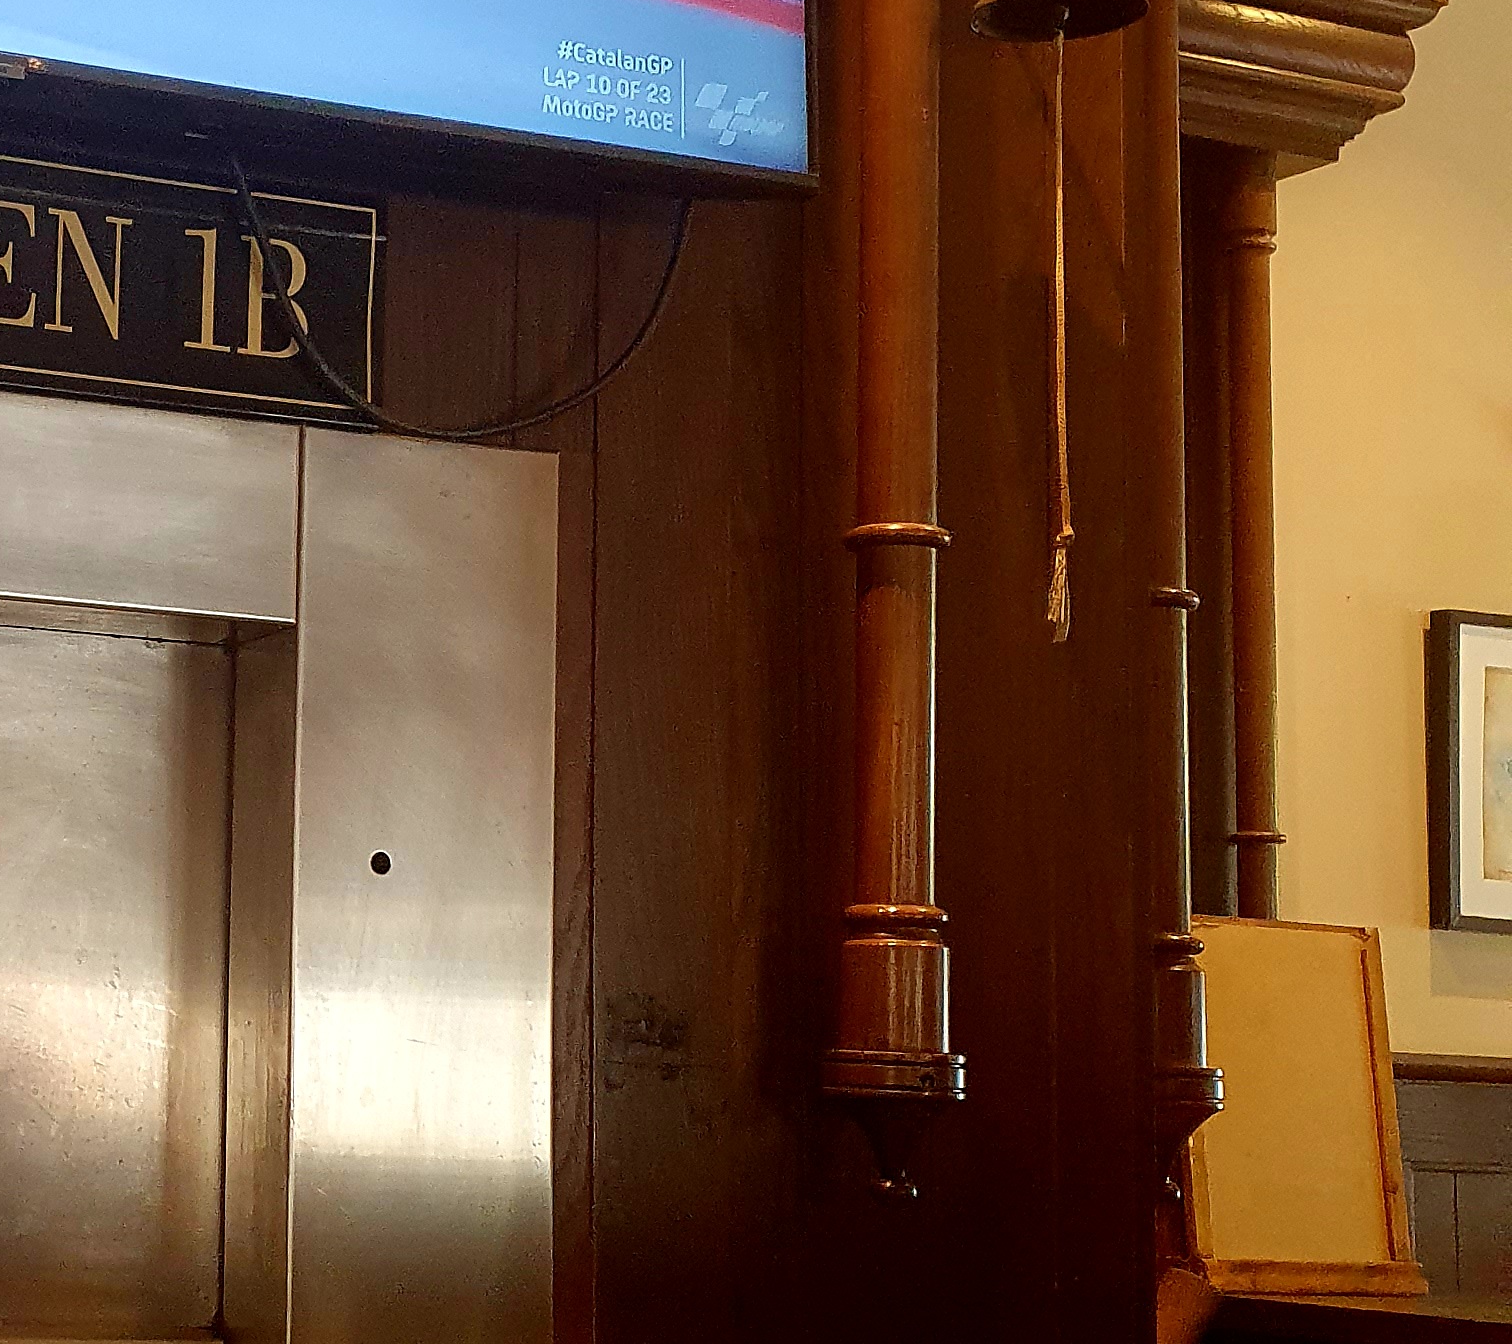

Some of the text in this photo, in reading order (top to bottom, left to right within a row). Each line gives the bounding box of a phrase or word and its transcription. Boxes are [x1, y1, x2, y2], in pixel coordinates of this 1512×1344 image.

[556, 39, 674, 76] #CatalanGP
[542, 66, 673, 105] LAP 10 OF 23
[542, 94, 674, 133] MotoGP RACE
[181, 225, 309, 360] 1B
